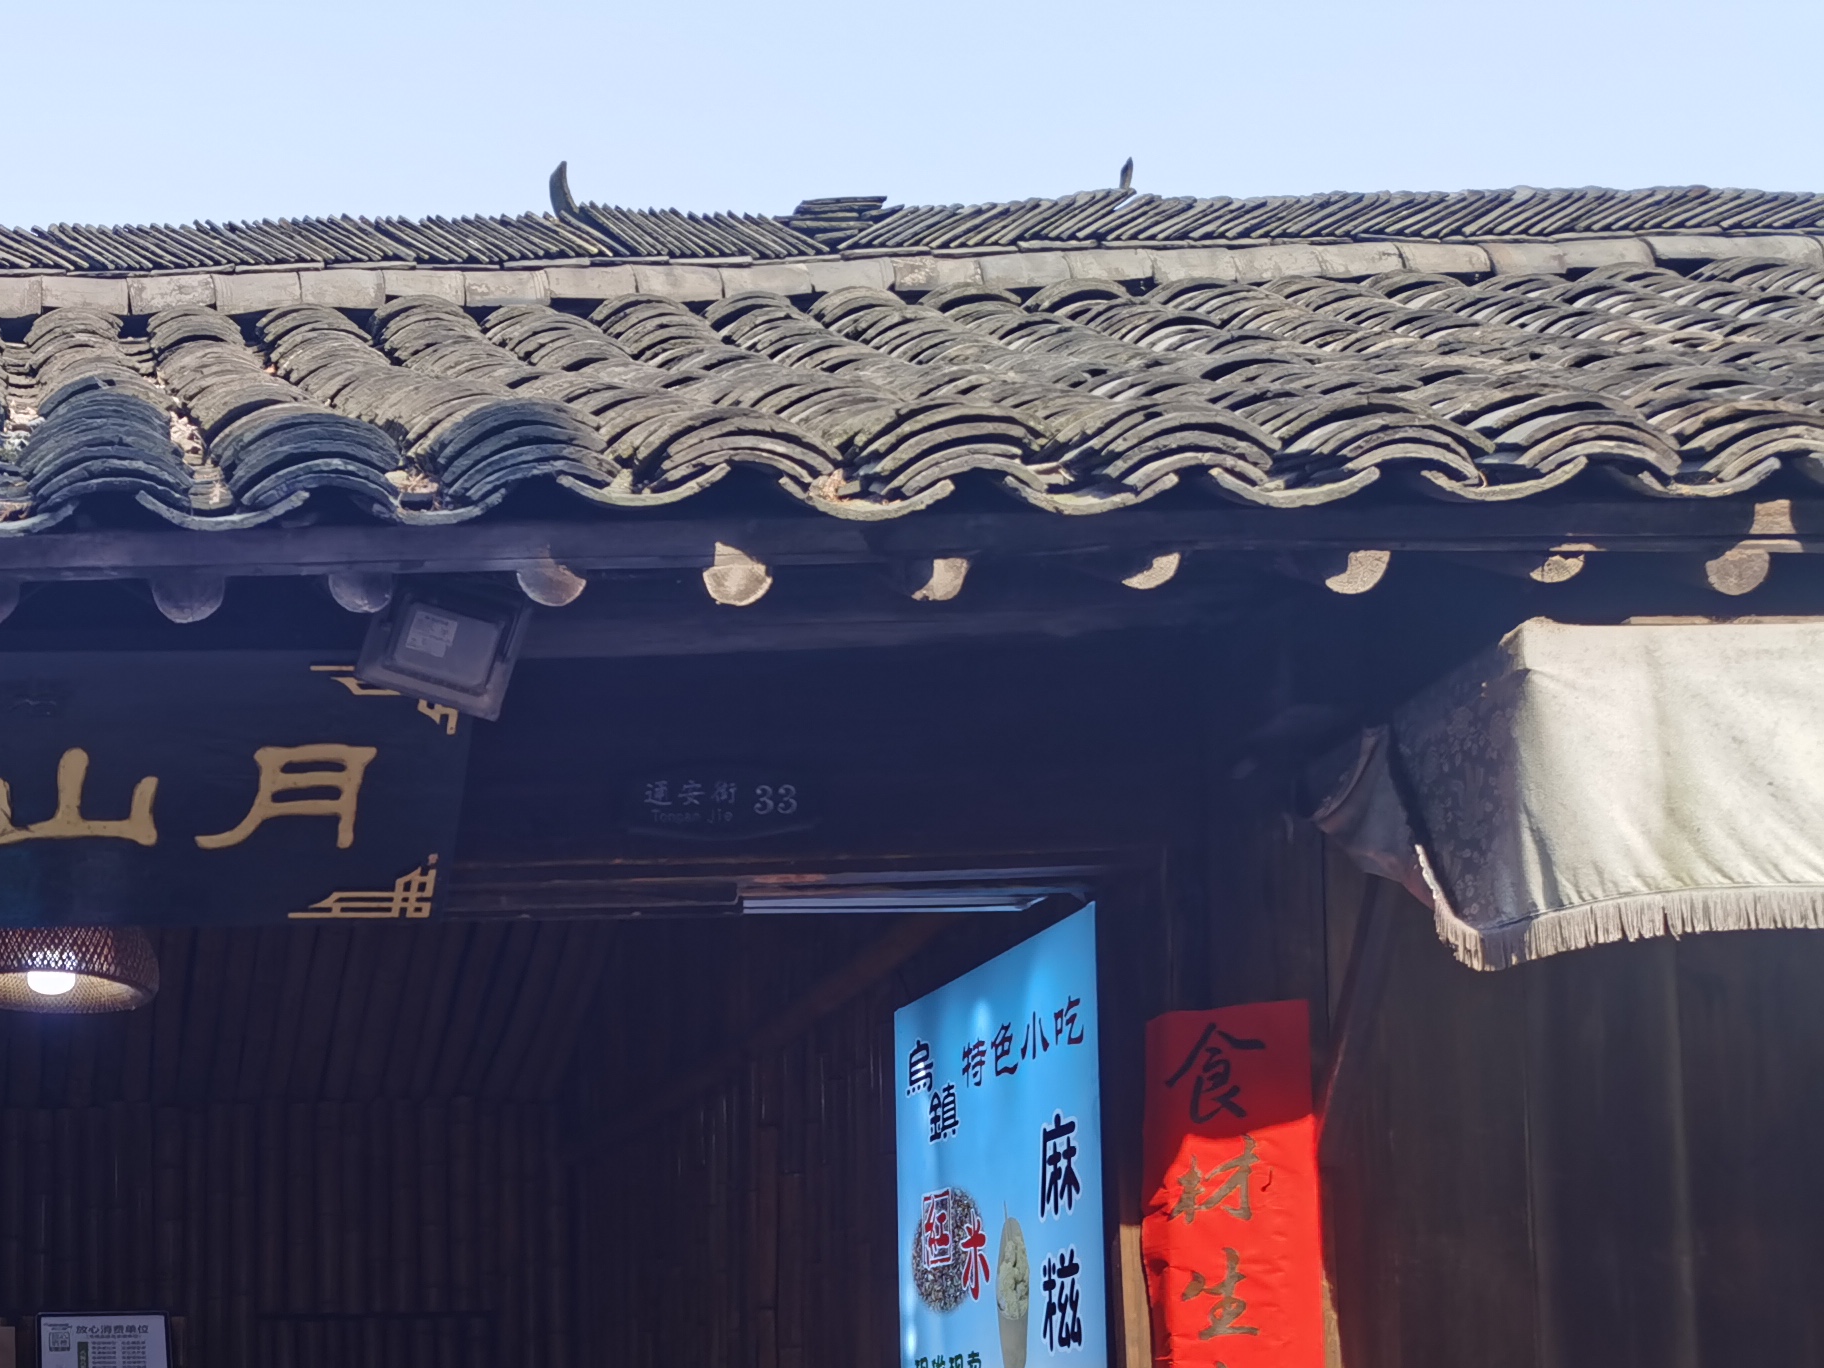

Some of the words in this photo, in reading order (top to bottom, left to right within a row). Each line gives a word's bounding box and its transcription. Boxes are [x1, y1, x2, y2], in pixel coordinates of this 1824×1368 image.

[753, 784, 798, 814] 33
[961, 995, 1085, 1088] 特色小吃
[1039, 1111, 1084, 1354] 麻糍
[76, 1324, 149, 1334] 放心消费单位
